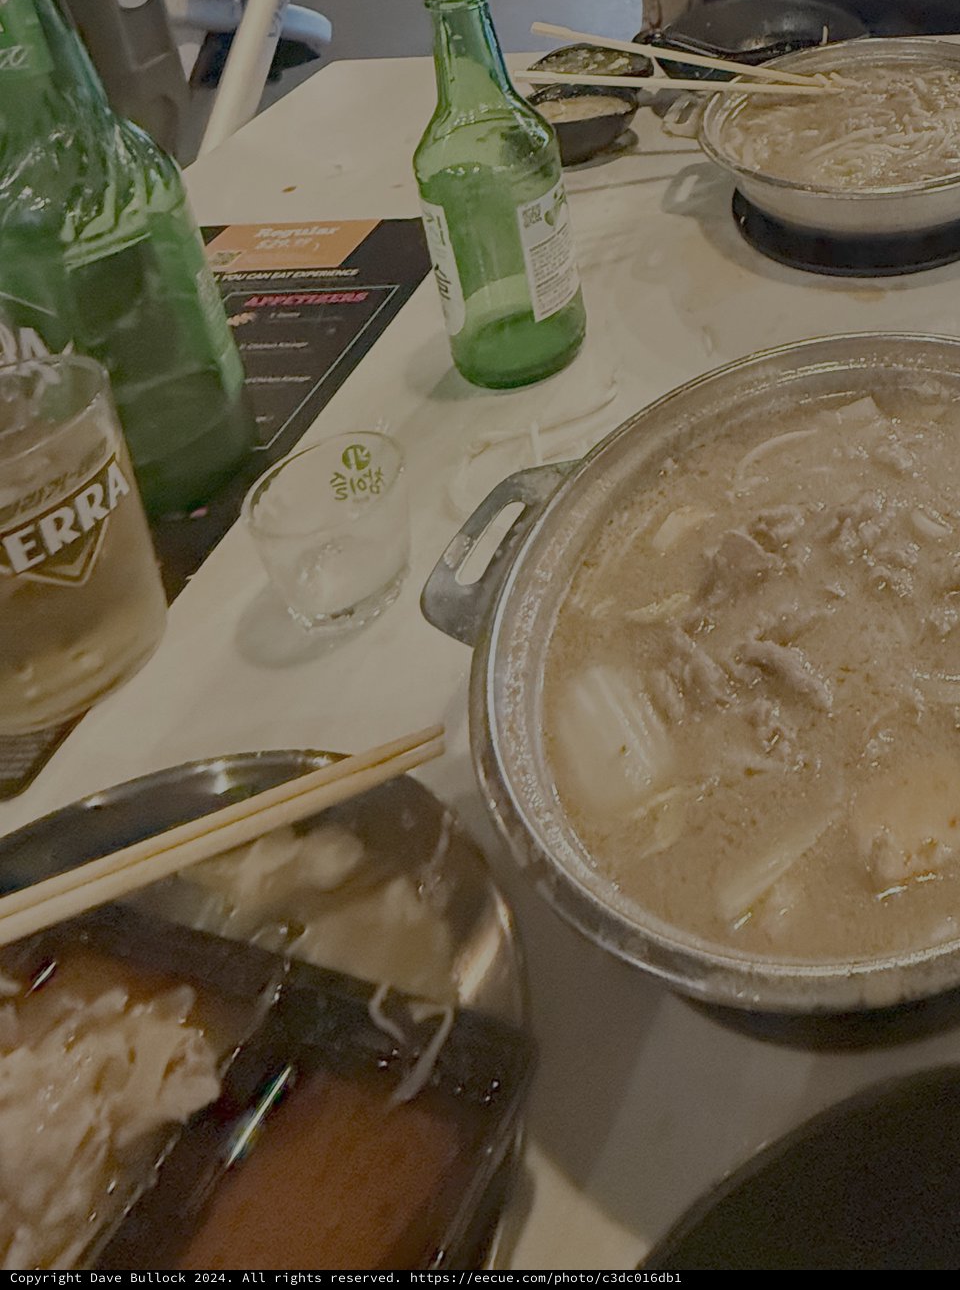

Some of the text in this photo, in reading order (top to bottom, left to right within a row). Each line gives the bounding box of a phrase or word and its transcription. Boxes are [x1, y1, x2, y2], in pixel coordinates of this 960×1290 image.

[256, 226, 340, 238] Regular
[221, 273, 248, 282] YOU
[248, 271, 271, 281] CAN
[271, 270, 292, 280] EAT
[292, 269, 359, 278] EXPERIENCE
[0, 459, 130, 575] ERRA
